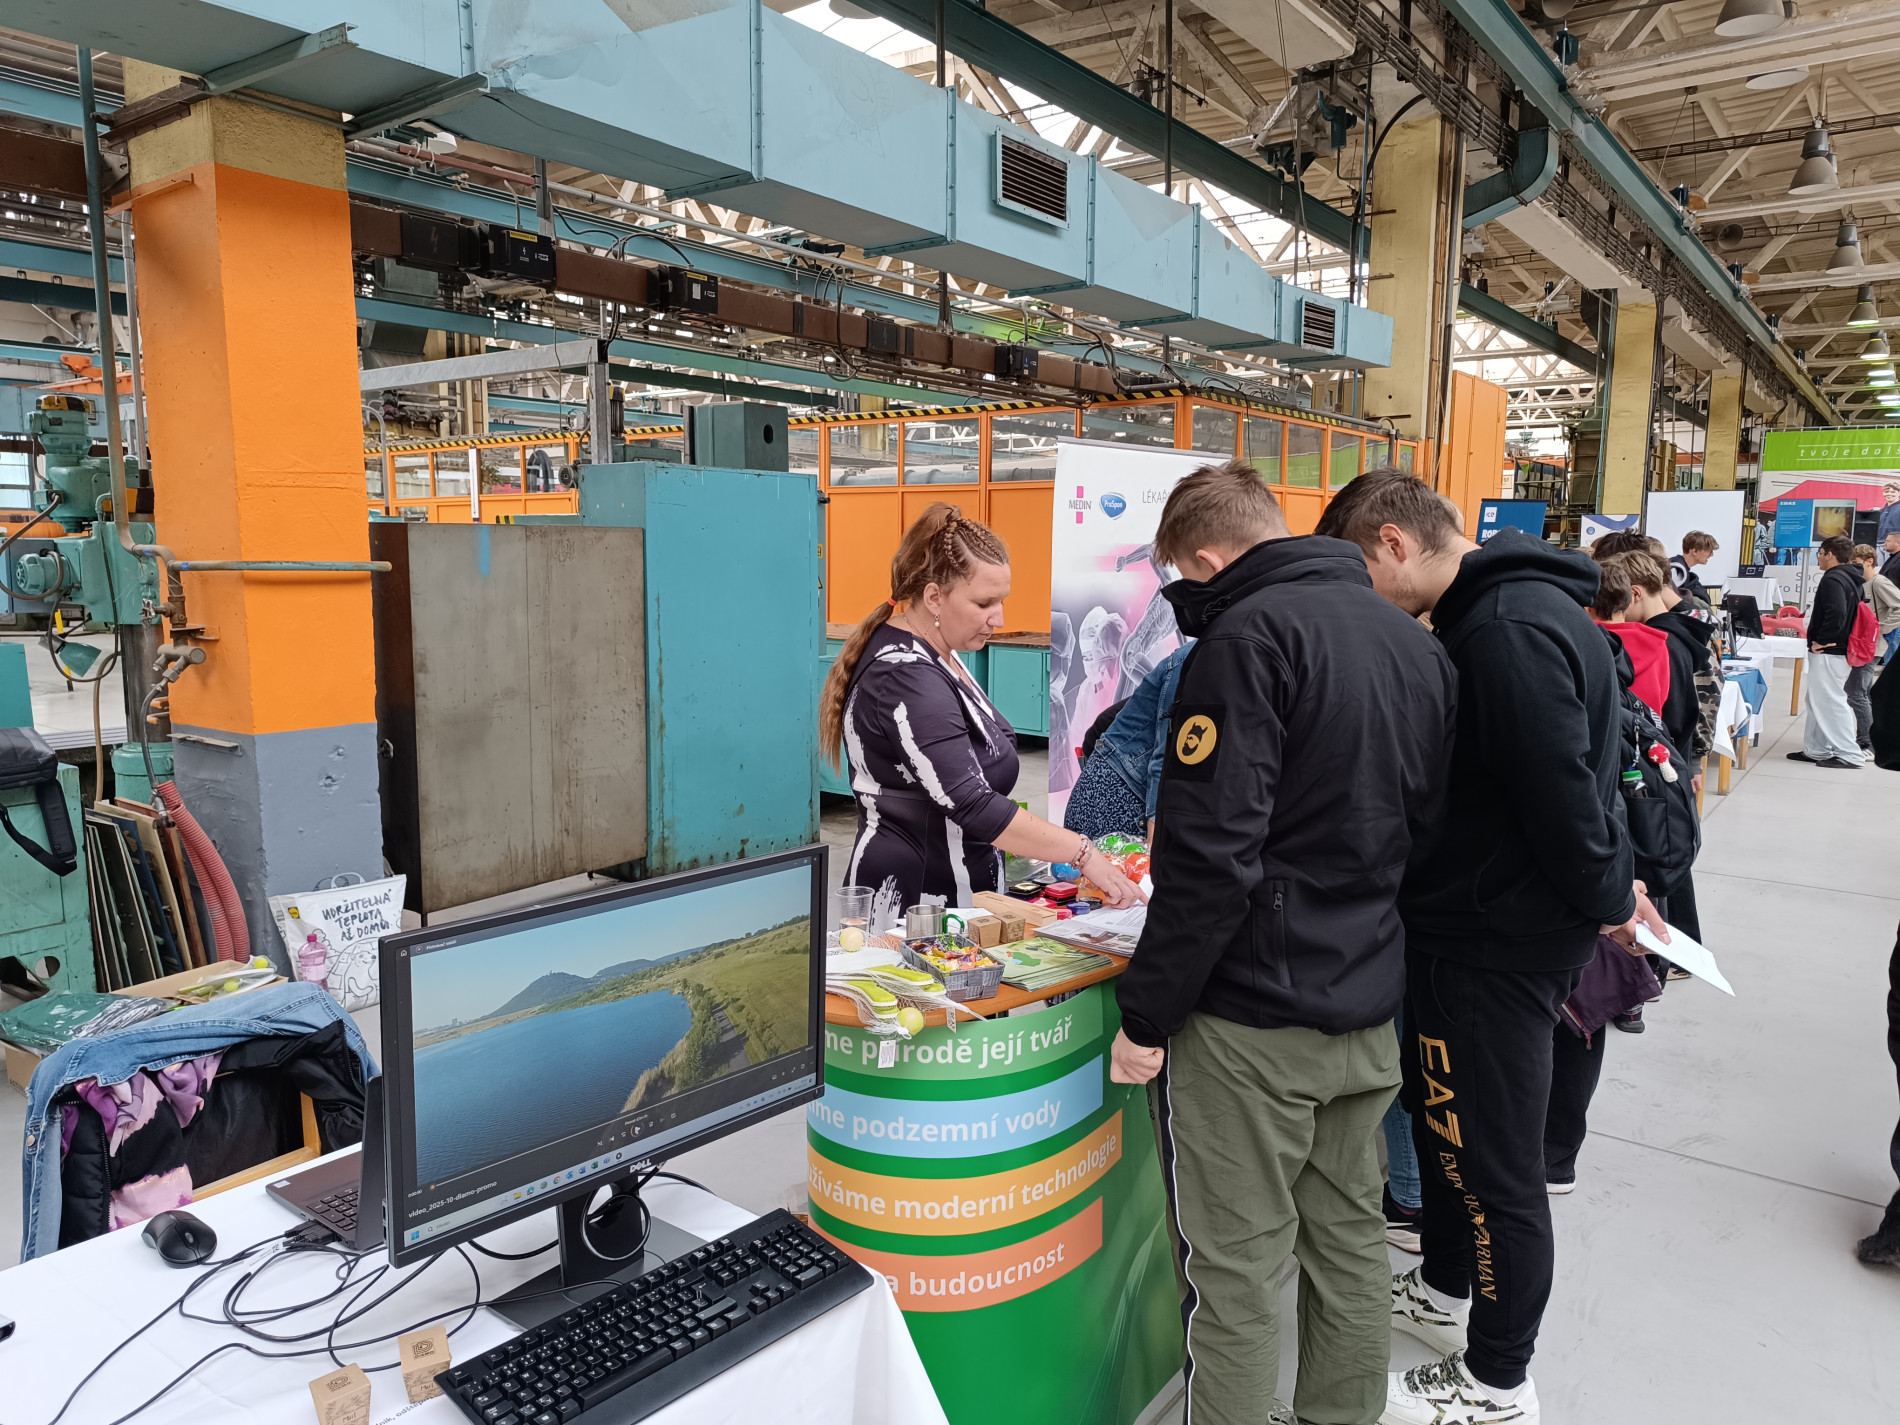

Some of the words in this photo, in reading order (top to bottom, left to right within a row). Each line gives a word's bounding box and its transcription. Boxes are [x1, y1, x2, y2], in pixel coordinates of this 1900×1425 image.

[1800, 447, 1850, 458] tvoje
[1068, 499, 1092, 510] MEDIN
[1142, 489, 1170, 504] LÉKAŘ
[825, 1029, 853, 1055] me
[978, 1030, 1025, 1069] její
[1030, 1014, 1072, 1052] tvář
[1419, 1033, 1464, 1148] EA7
[852, 1112, 997, 1142] podzemní
[1004, 1100, 1062, 1134] vody
[629, 1158, 652, 1174] DELL
[894, 1185, 1016, 1220] moderní
[1021, 1134, 1116, 1205] technologie
[909, 1242, 1065, 1296] budoucnost
